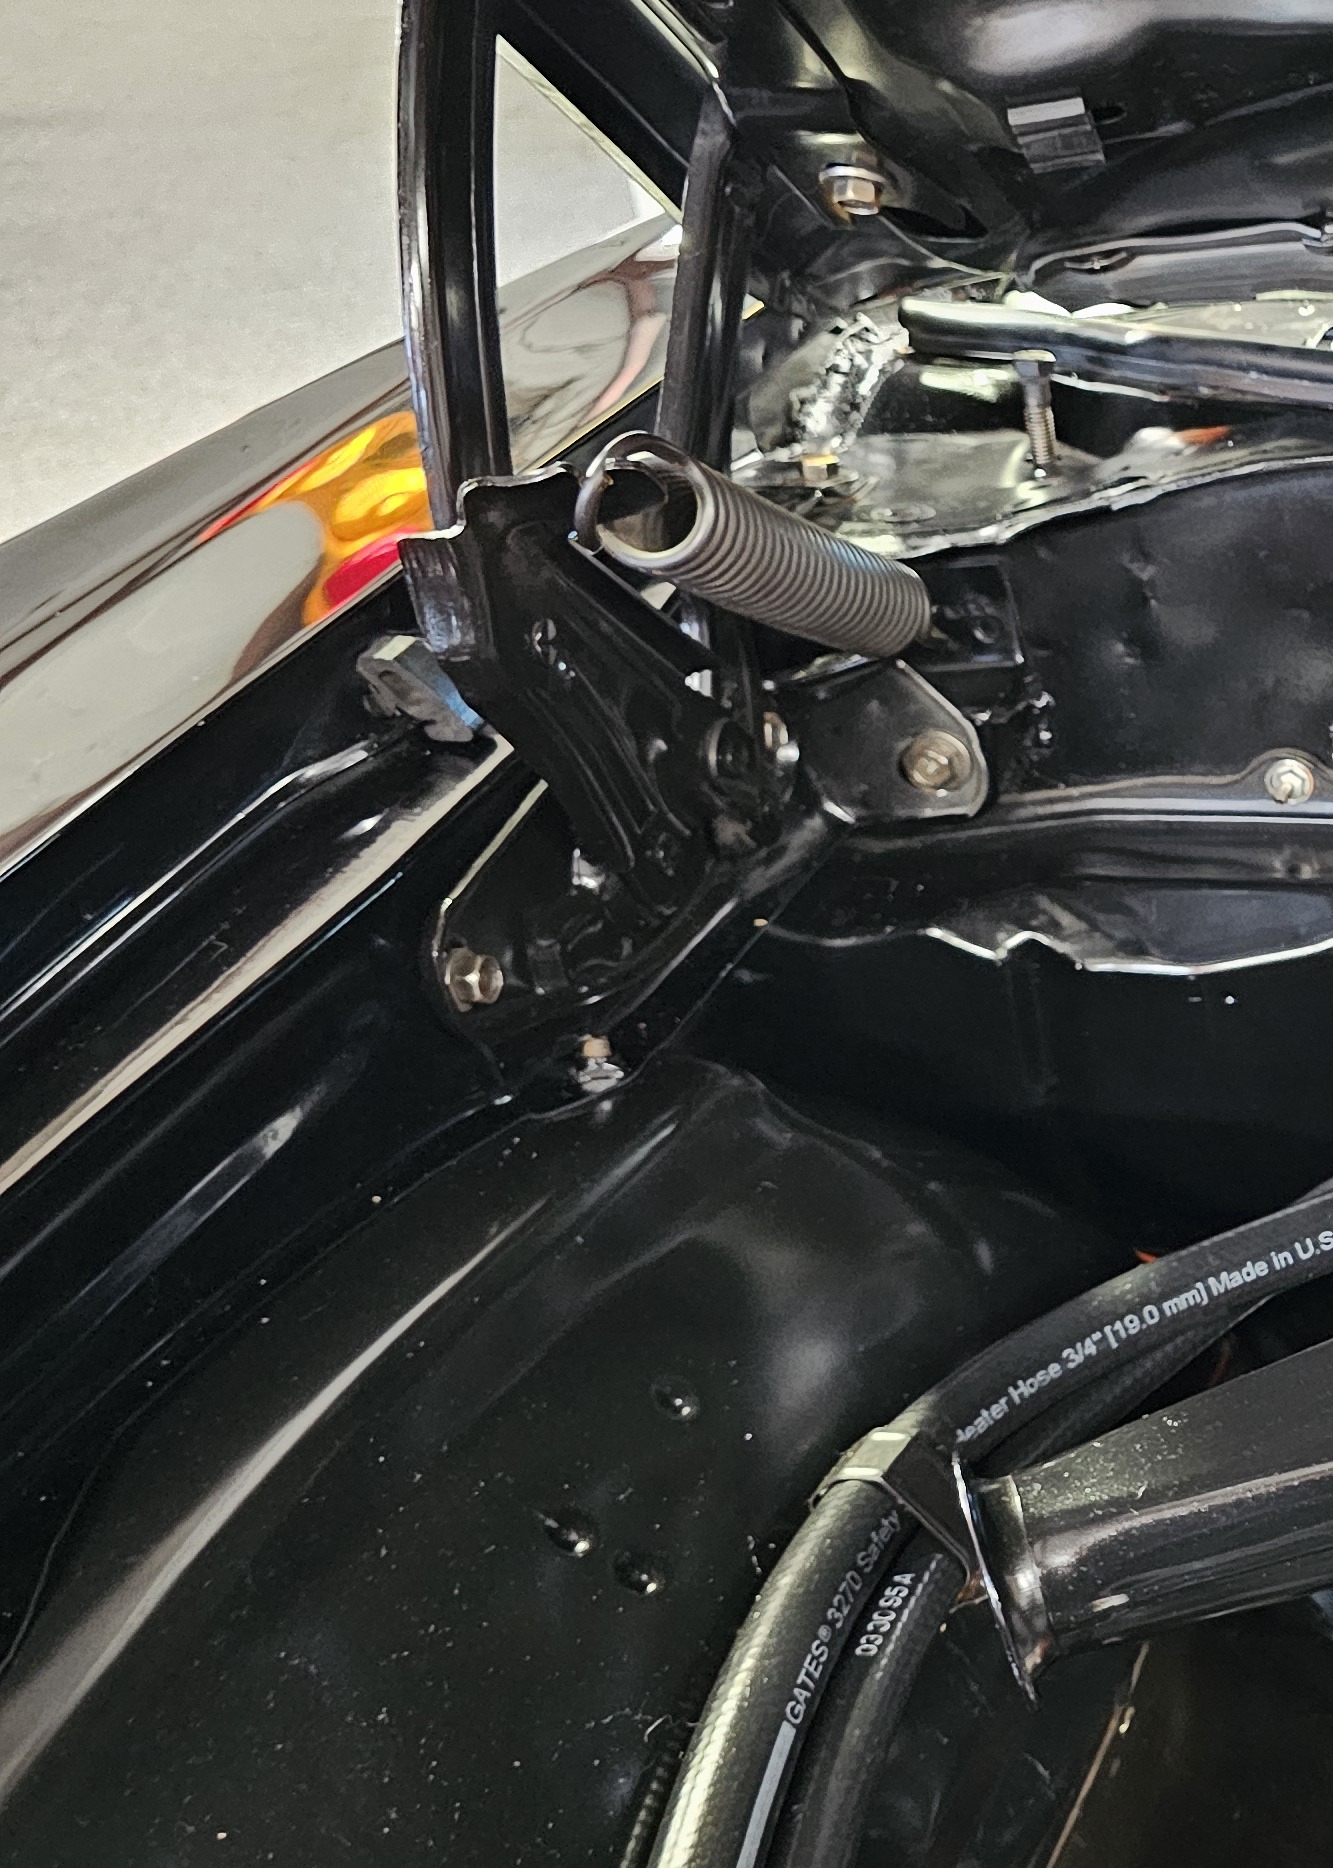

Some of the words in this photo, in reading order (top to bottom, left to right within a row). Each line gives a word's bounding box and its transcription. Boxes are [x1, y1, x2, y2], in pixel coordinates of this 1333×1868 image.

[1007, 1362, 1062, 1405] Hose
[1062, 1331, 1102, 1369] 3/4"
[1103, 1305, 1159, 1349] [19.0
[1162, 1281, 1208, 1317] mm]
[1207, 1261, 1268, 1296] Made
[1270, 1251, 1294, 1270] in
[827, 1571, 862, 1628] 3270
[857, 1509, 899, 1573] Safety
